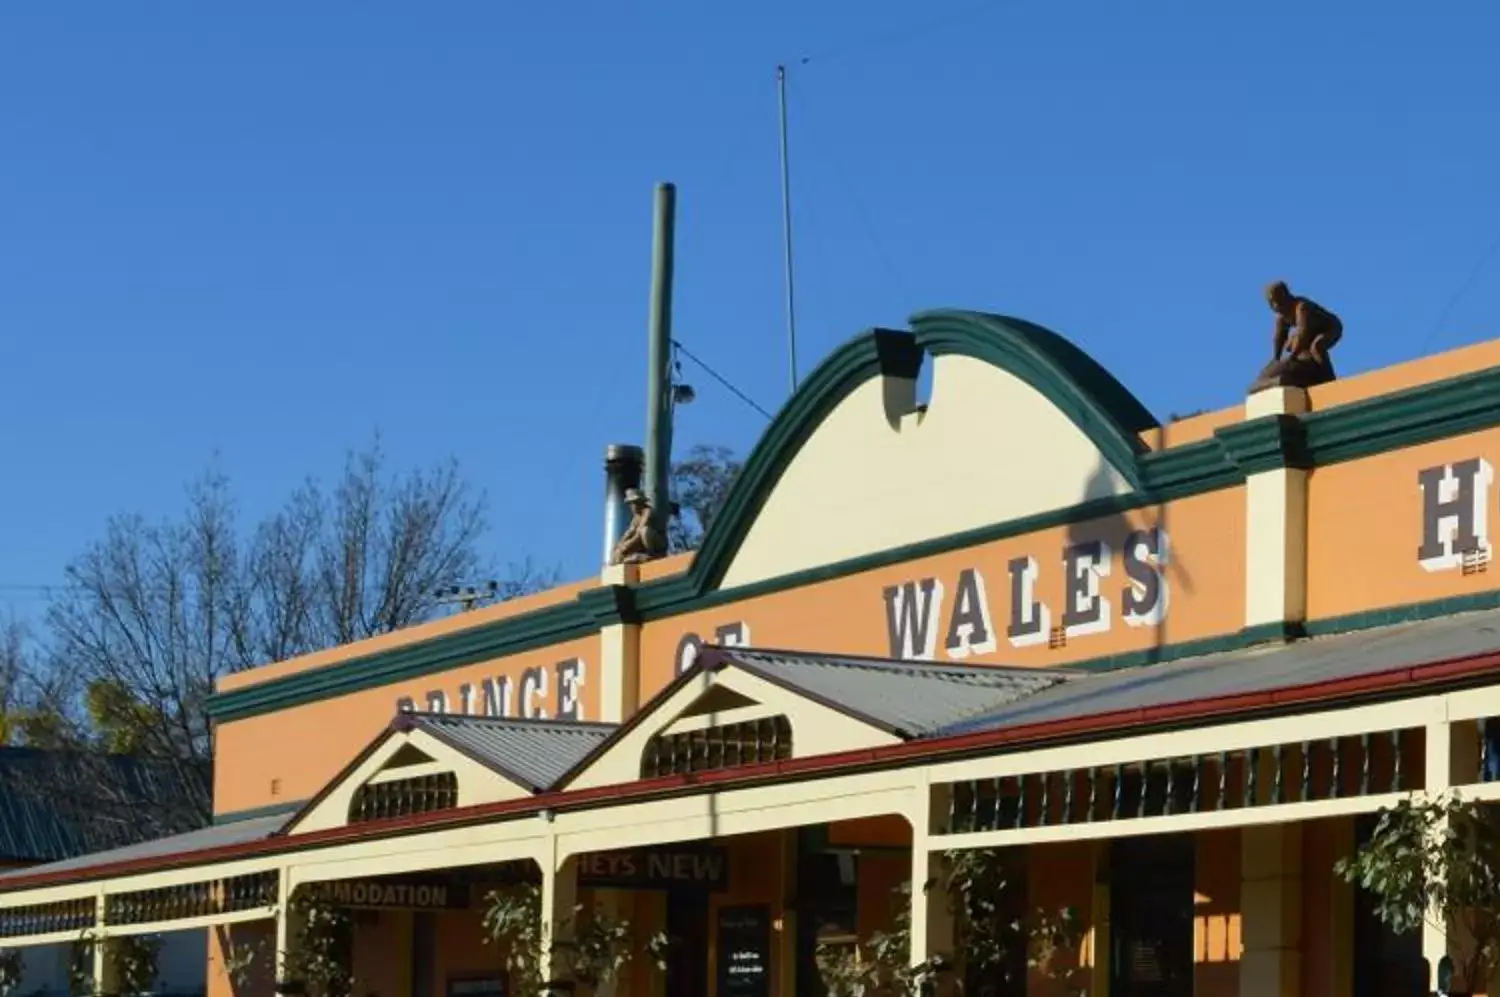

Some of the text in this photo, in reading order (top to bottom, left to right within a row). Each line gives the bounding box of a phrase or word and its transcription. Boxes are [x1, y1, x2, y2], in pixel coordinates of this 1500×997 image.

[397, 657, 587, 721] INCE
[882, 527, 1169, 660] WALES
[646, 852, 725, 881] NEW
